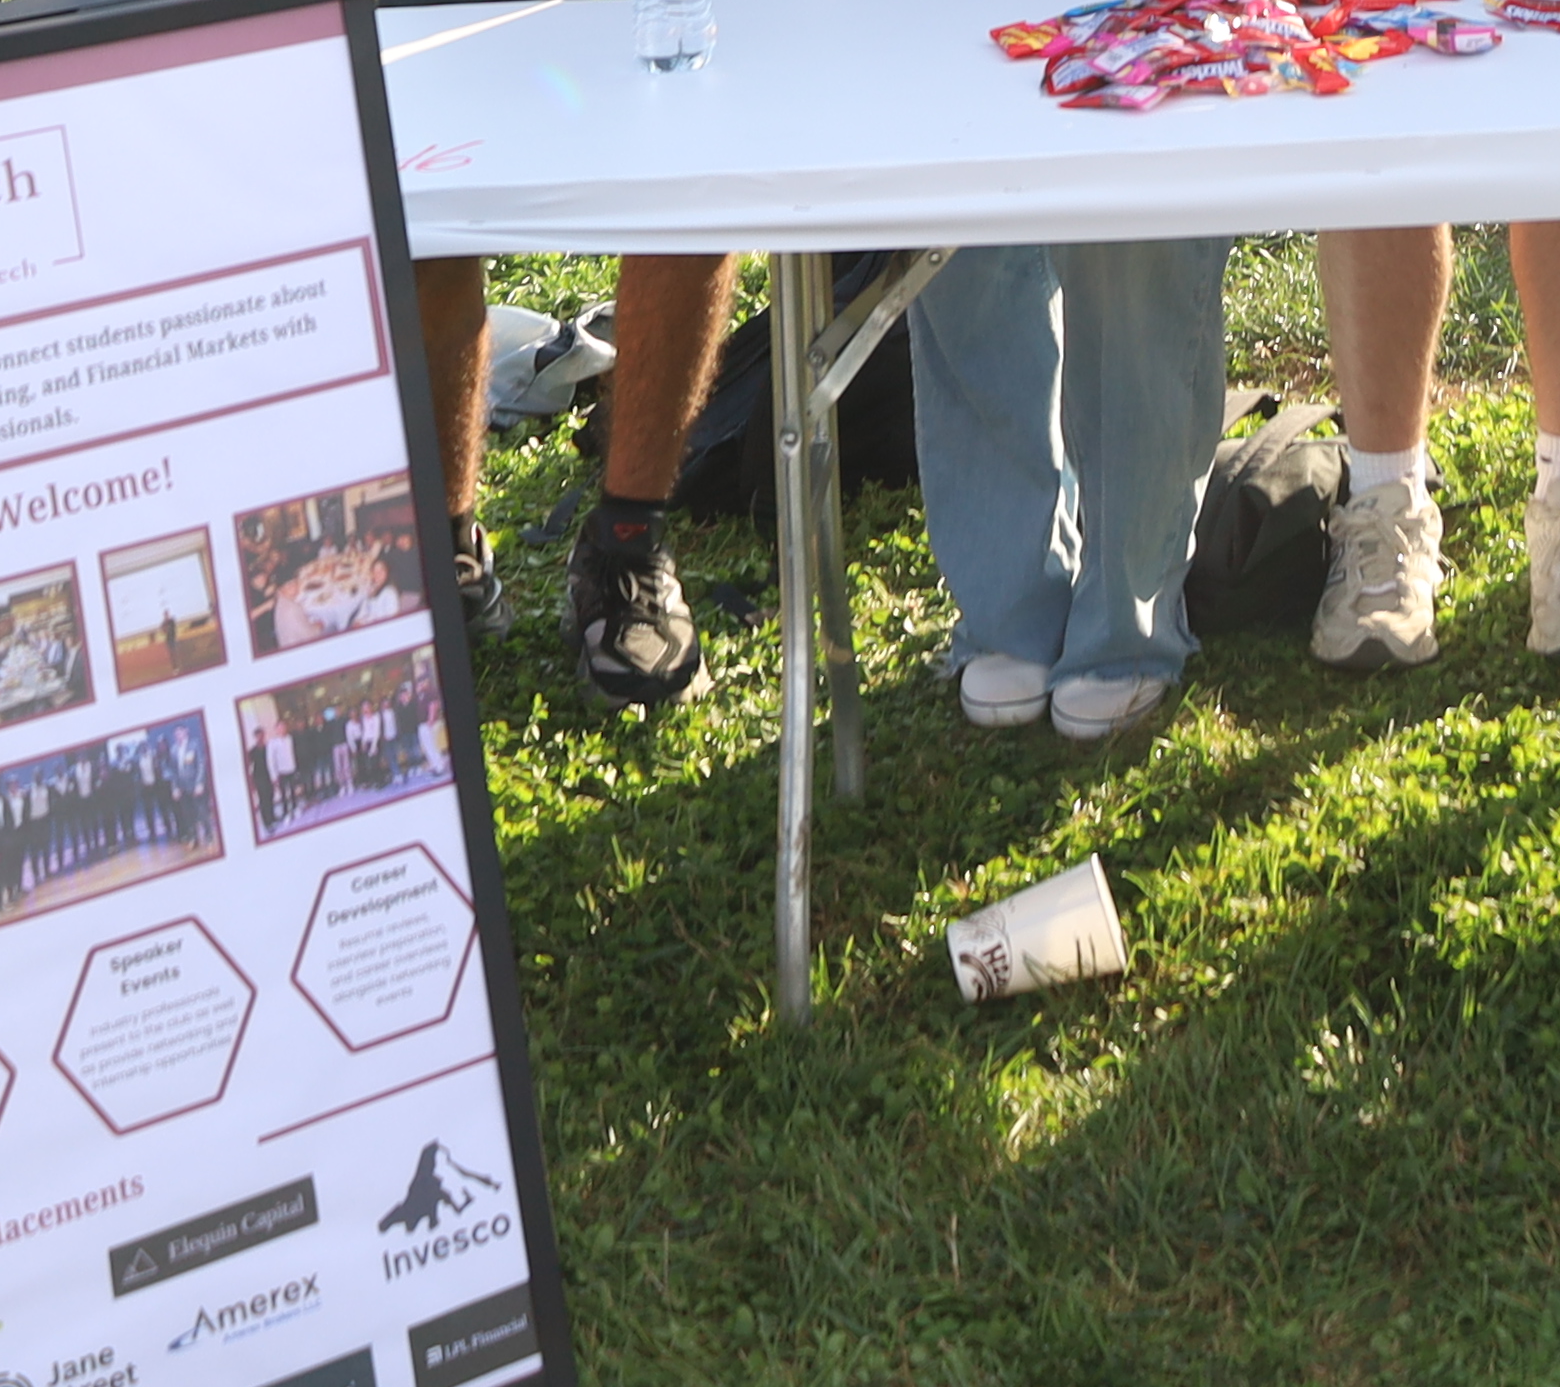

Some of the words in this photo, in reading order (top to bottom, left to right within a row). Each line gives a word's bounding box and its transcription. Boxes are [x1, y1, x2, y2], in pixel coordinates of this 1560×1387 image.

[65, 321, 155, 355] students
[159, 295, 265, 339] passionate
[270, 279, 326, 308] about
[41, 367, 81, 396] and
[86, 343, 181, 385] Financial
[185, 328, 269, 360] Markets
[272, 312, 317, 340] with
[382, 1213, 511, 1281] Invesco
[189, 1273, 319, 1343] Amerex
[45, 1344, 116, 1387] Jane
